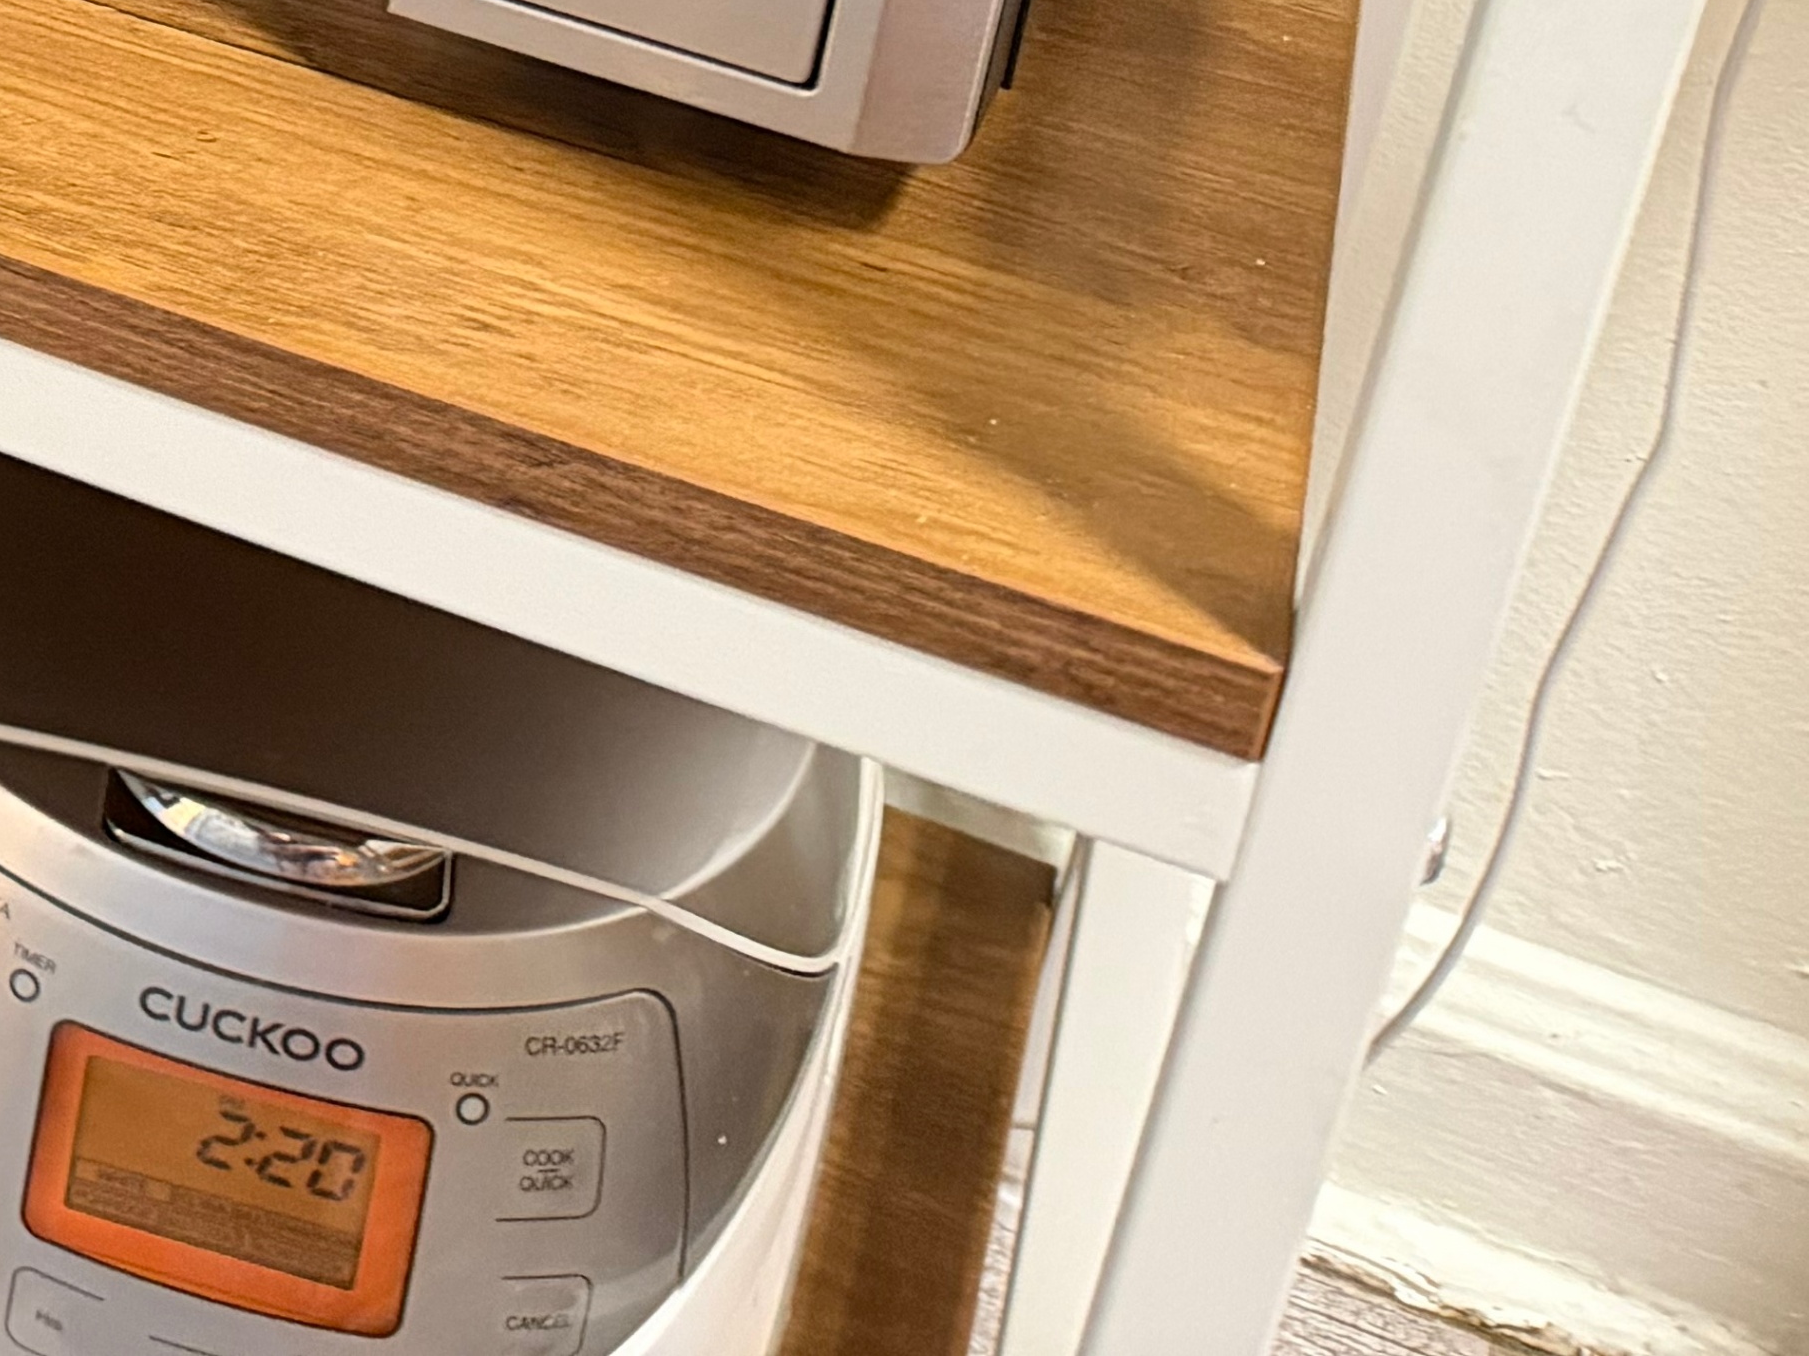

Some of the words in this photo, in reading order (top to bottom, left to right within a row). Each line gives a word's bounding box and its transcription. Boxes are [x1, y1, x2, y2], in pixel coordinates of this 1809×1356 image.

[13, 942, 56, 975] TIMER
[139, 986, 365, 1071] CUCKOO
[450, 1073, 500, 1088] QUICK
[195, 1109, 365, 1202] 2:20
[523, 1150, 574, 1167] COOK
[520, 1176, 574, 1192] QUICK
[506, 1316, 573, 1332] CANCEL
